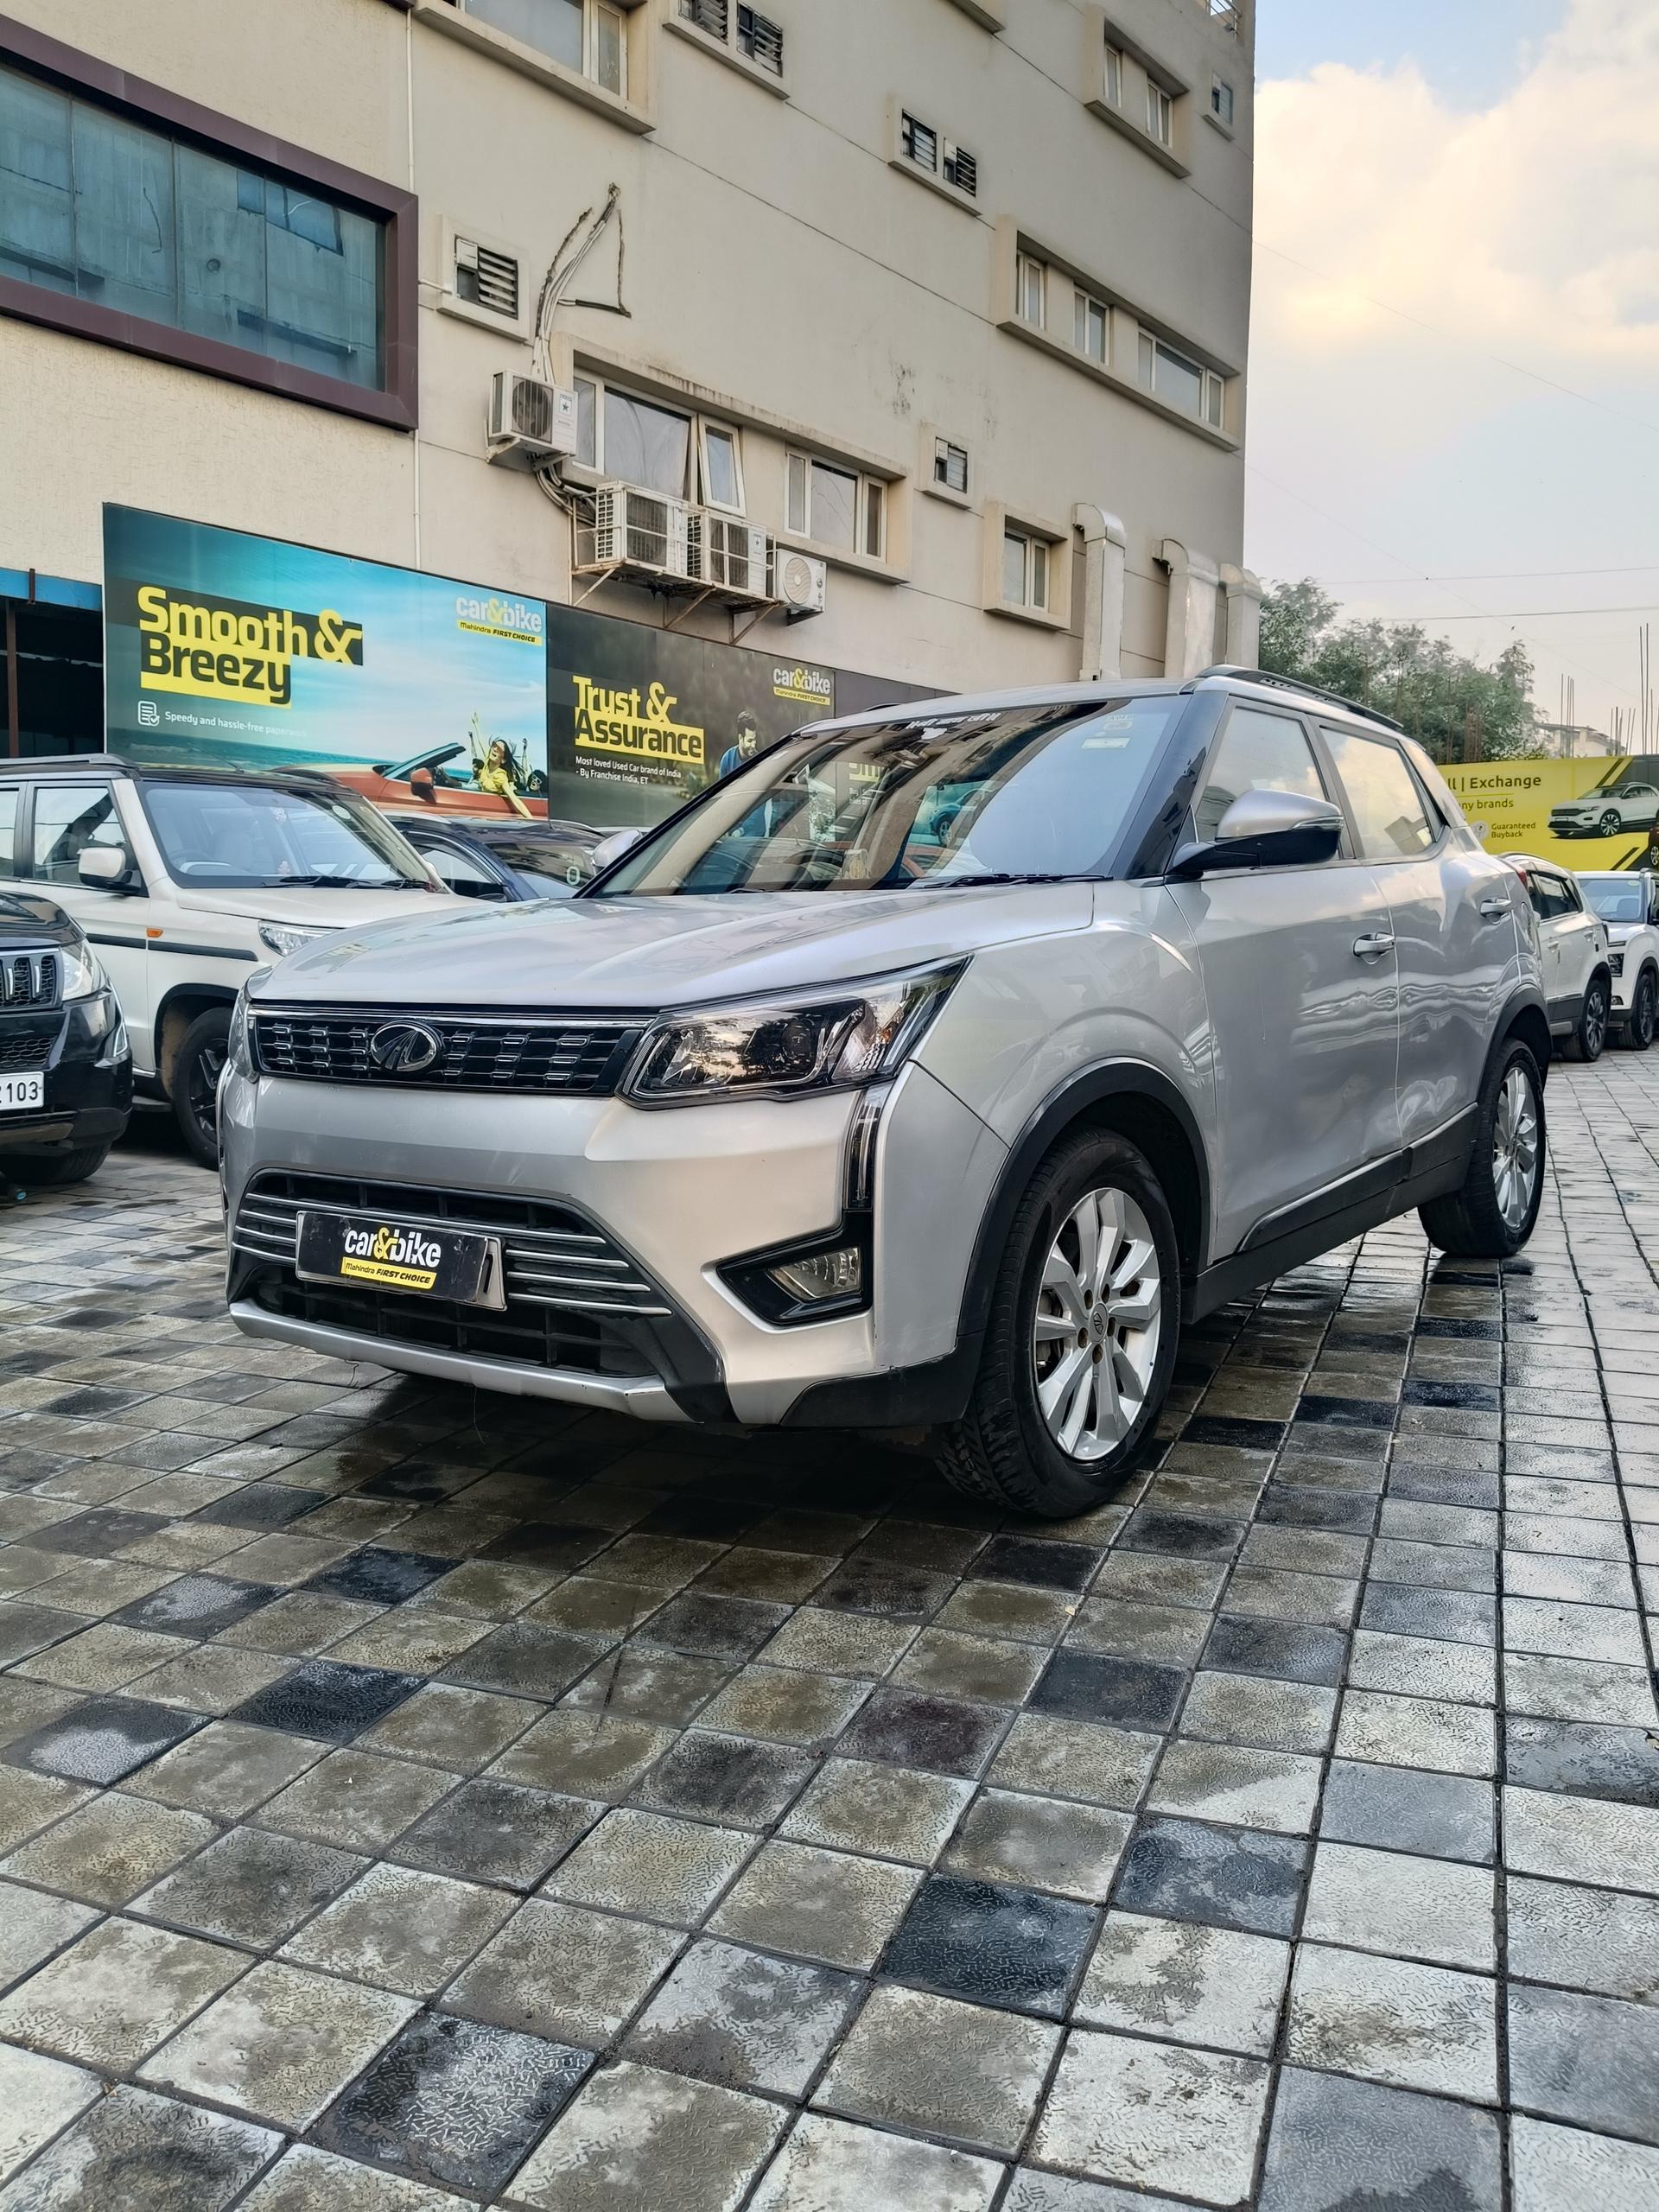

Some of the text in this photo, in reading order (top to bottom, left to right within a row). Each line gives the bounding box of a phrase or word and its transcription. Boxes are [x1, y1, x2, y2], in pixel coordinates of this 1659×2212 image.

[137, 586, 363, 665] Smooth &
[456, 596, 542, 632] car&bike
[493, 629, 512, 638] FIRST
[512, 633, 536, 643] CHOICE
[140, 630, 291, 705] Breezy
[773, 667, 830, 695] car&bike
[572, 675, 677, 725] Trust &
[165, 711, 198, 726] Speedy
[200, 716, 216, 727] and
[218, 717, 264, 733] hassle-free
[575, 708, 702, 758] Assurance
[575, 755, 682, 779] Most loved Used Car brand of India
[580, 768, 589, 779] By
[590, 769, 621, 781] Franchise
[640, 776, 649, 785] ET
[1447, 777, 1457, 790] ll
[1470, 775, 1541, 789] Exchange
[1459, 798, 1514, 811] ny brands
[1491, 822, 1536, 830] Guaranteed
[0, 1081, 38, 1103] 103
[344, 1227, 442, 1268] car&bike
[346, 1262, 431, 1284] Mahindra FIRST CHOICE
